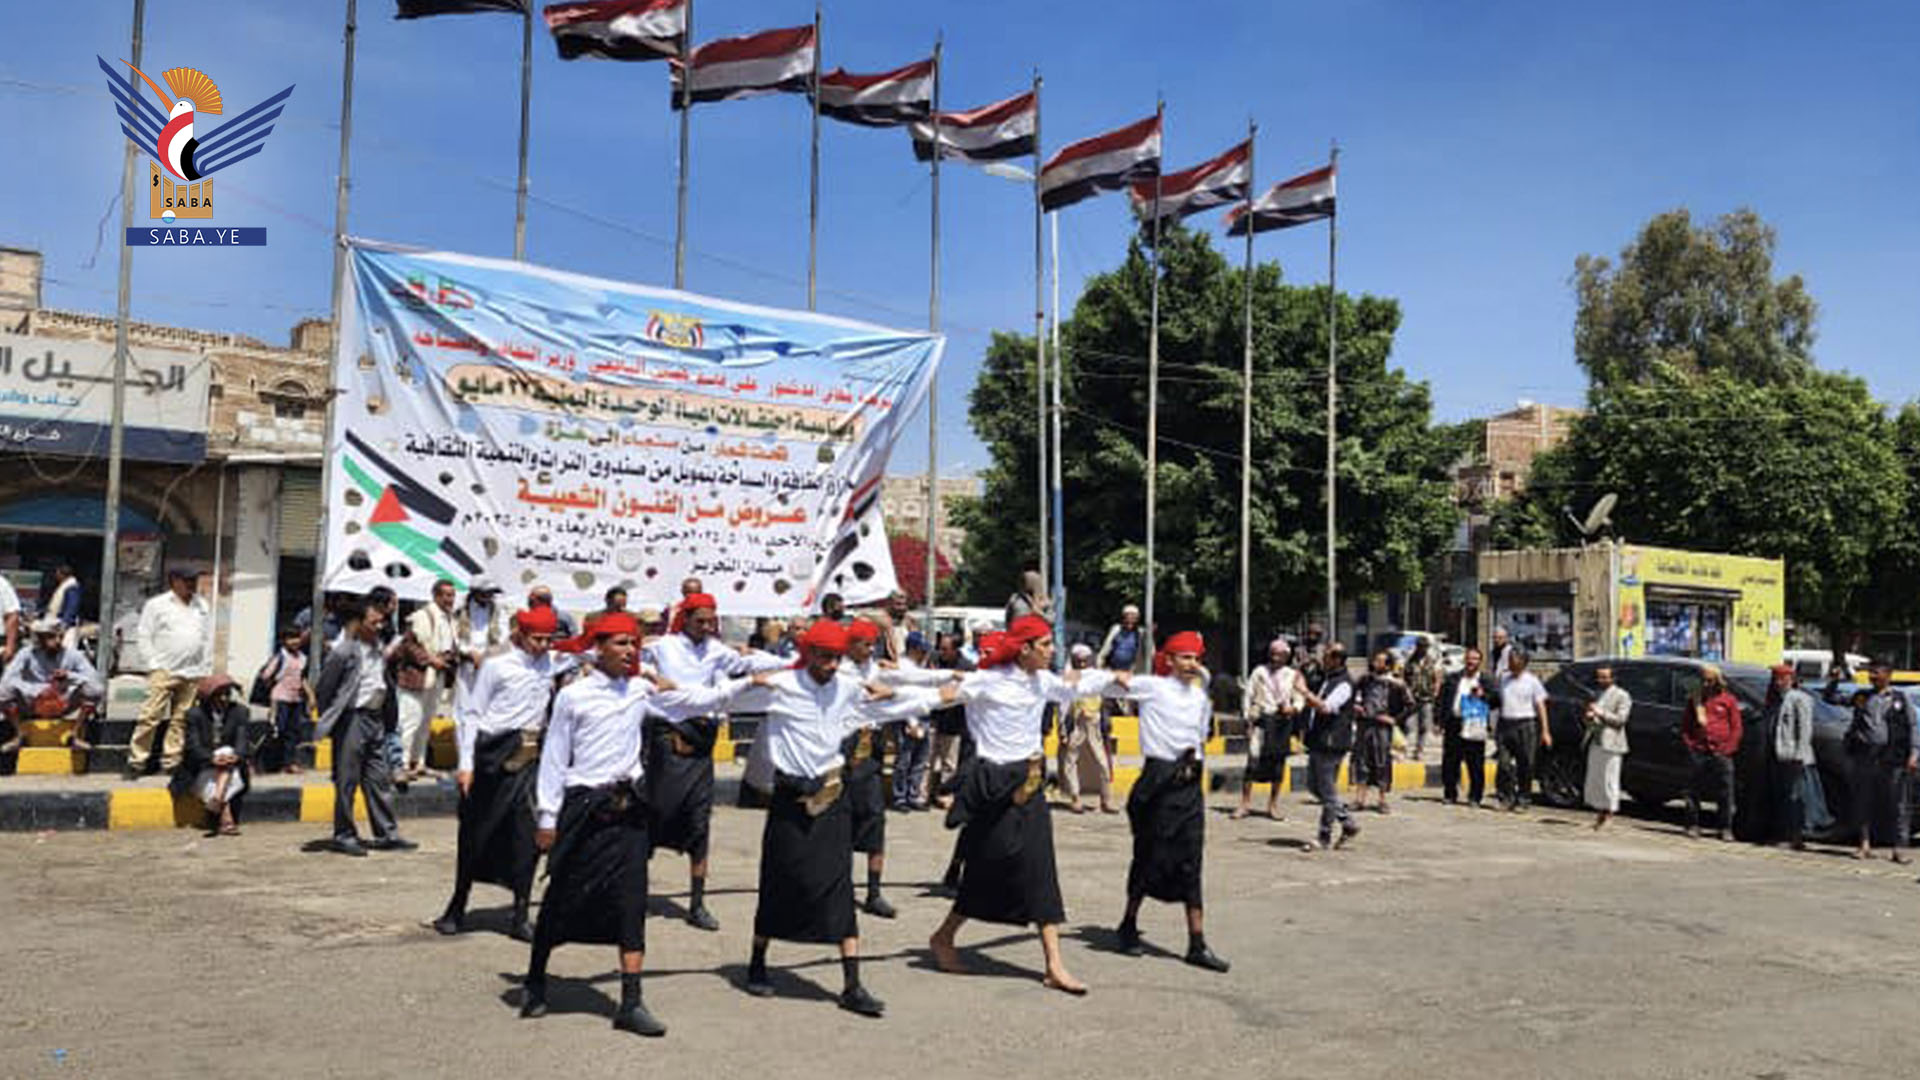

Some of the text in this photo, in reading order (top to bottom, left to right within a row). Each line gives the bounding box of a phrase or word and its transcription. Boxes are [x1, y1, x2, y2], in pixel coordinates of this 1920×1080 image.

[458, 371, 504, 402] مايو
[404, 430, 473, 461] الثقافية
[544, 420, 587, 443] غزة
[680, 436, 705, 455] من
[475, 439, 538, 472] والتنمية
[539, 444, 588, 476] التراث
[588, 451, 647, 480] صندوق
[648, 459, 672, 484] من
[516, 477, 807, 528] عروض من الفنون الشعبية
